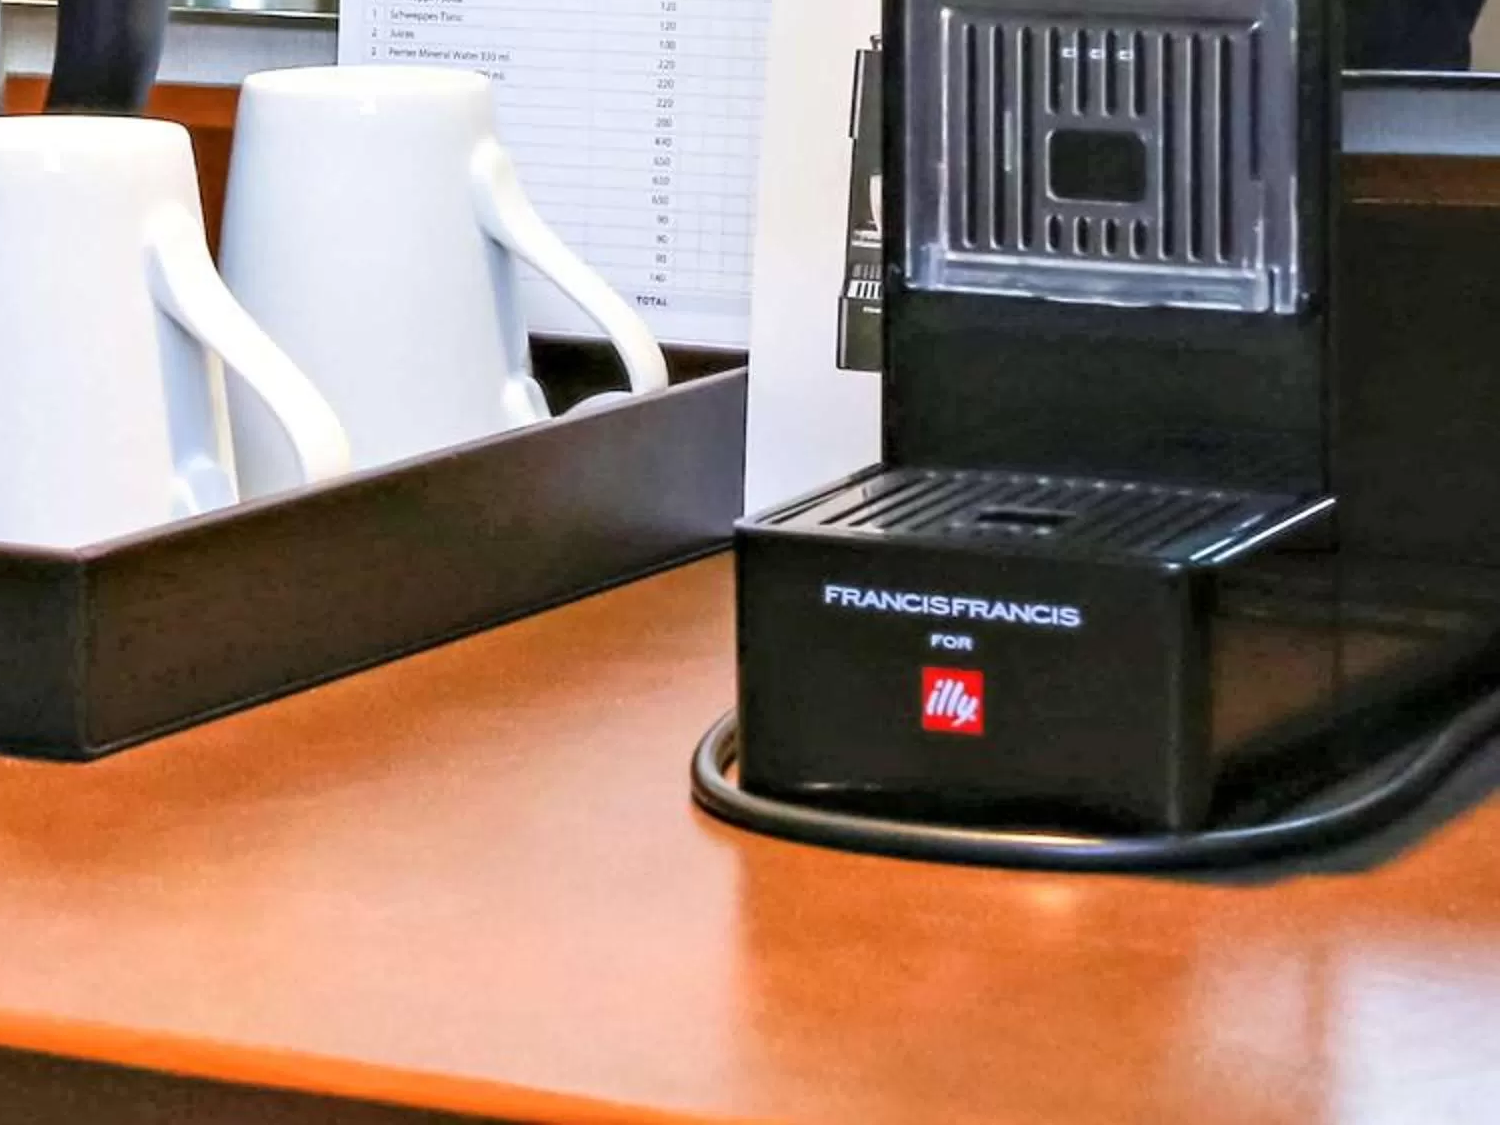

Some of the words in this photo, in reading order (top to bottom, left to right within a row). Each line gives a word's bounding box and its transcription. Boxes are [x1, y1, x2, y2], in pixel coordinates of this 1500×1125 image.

[390, 9, 438, 23] Schweppes
[635, 294, 668, 307] TOTAL
[823, 583, 1082, 628] FRANCISFRANCIS
[929, 633, 974, 652] FOR
[925, 678, 980, 727] illy
